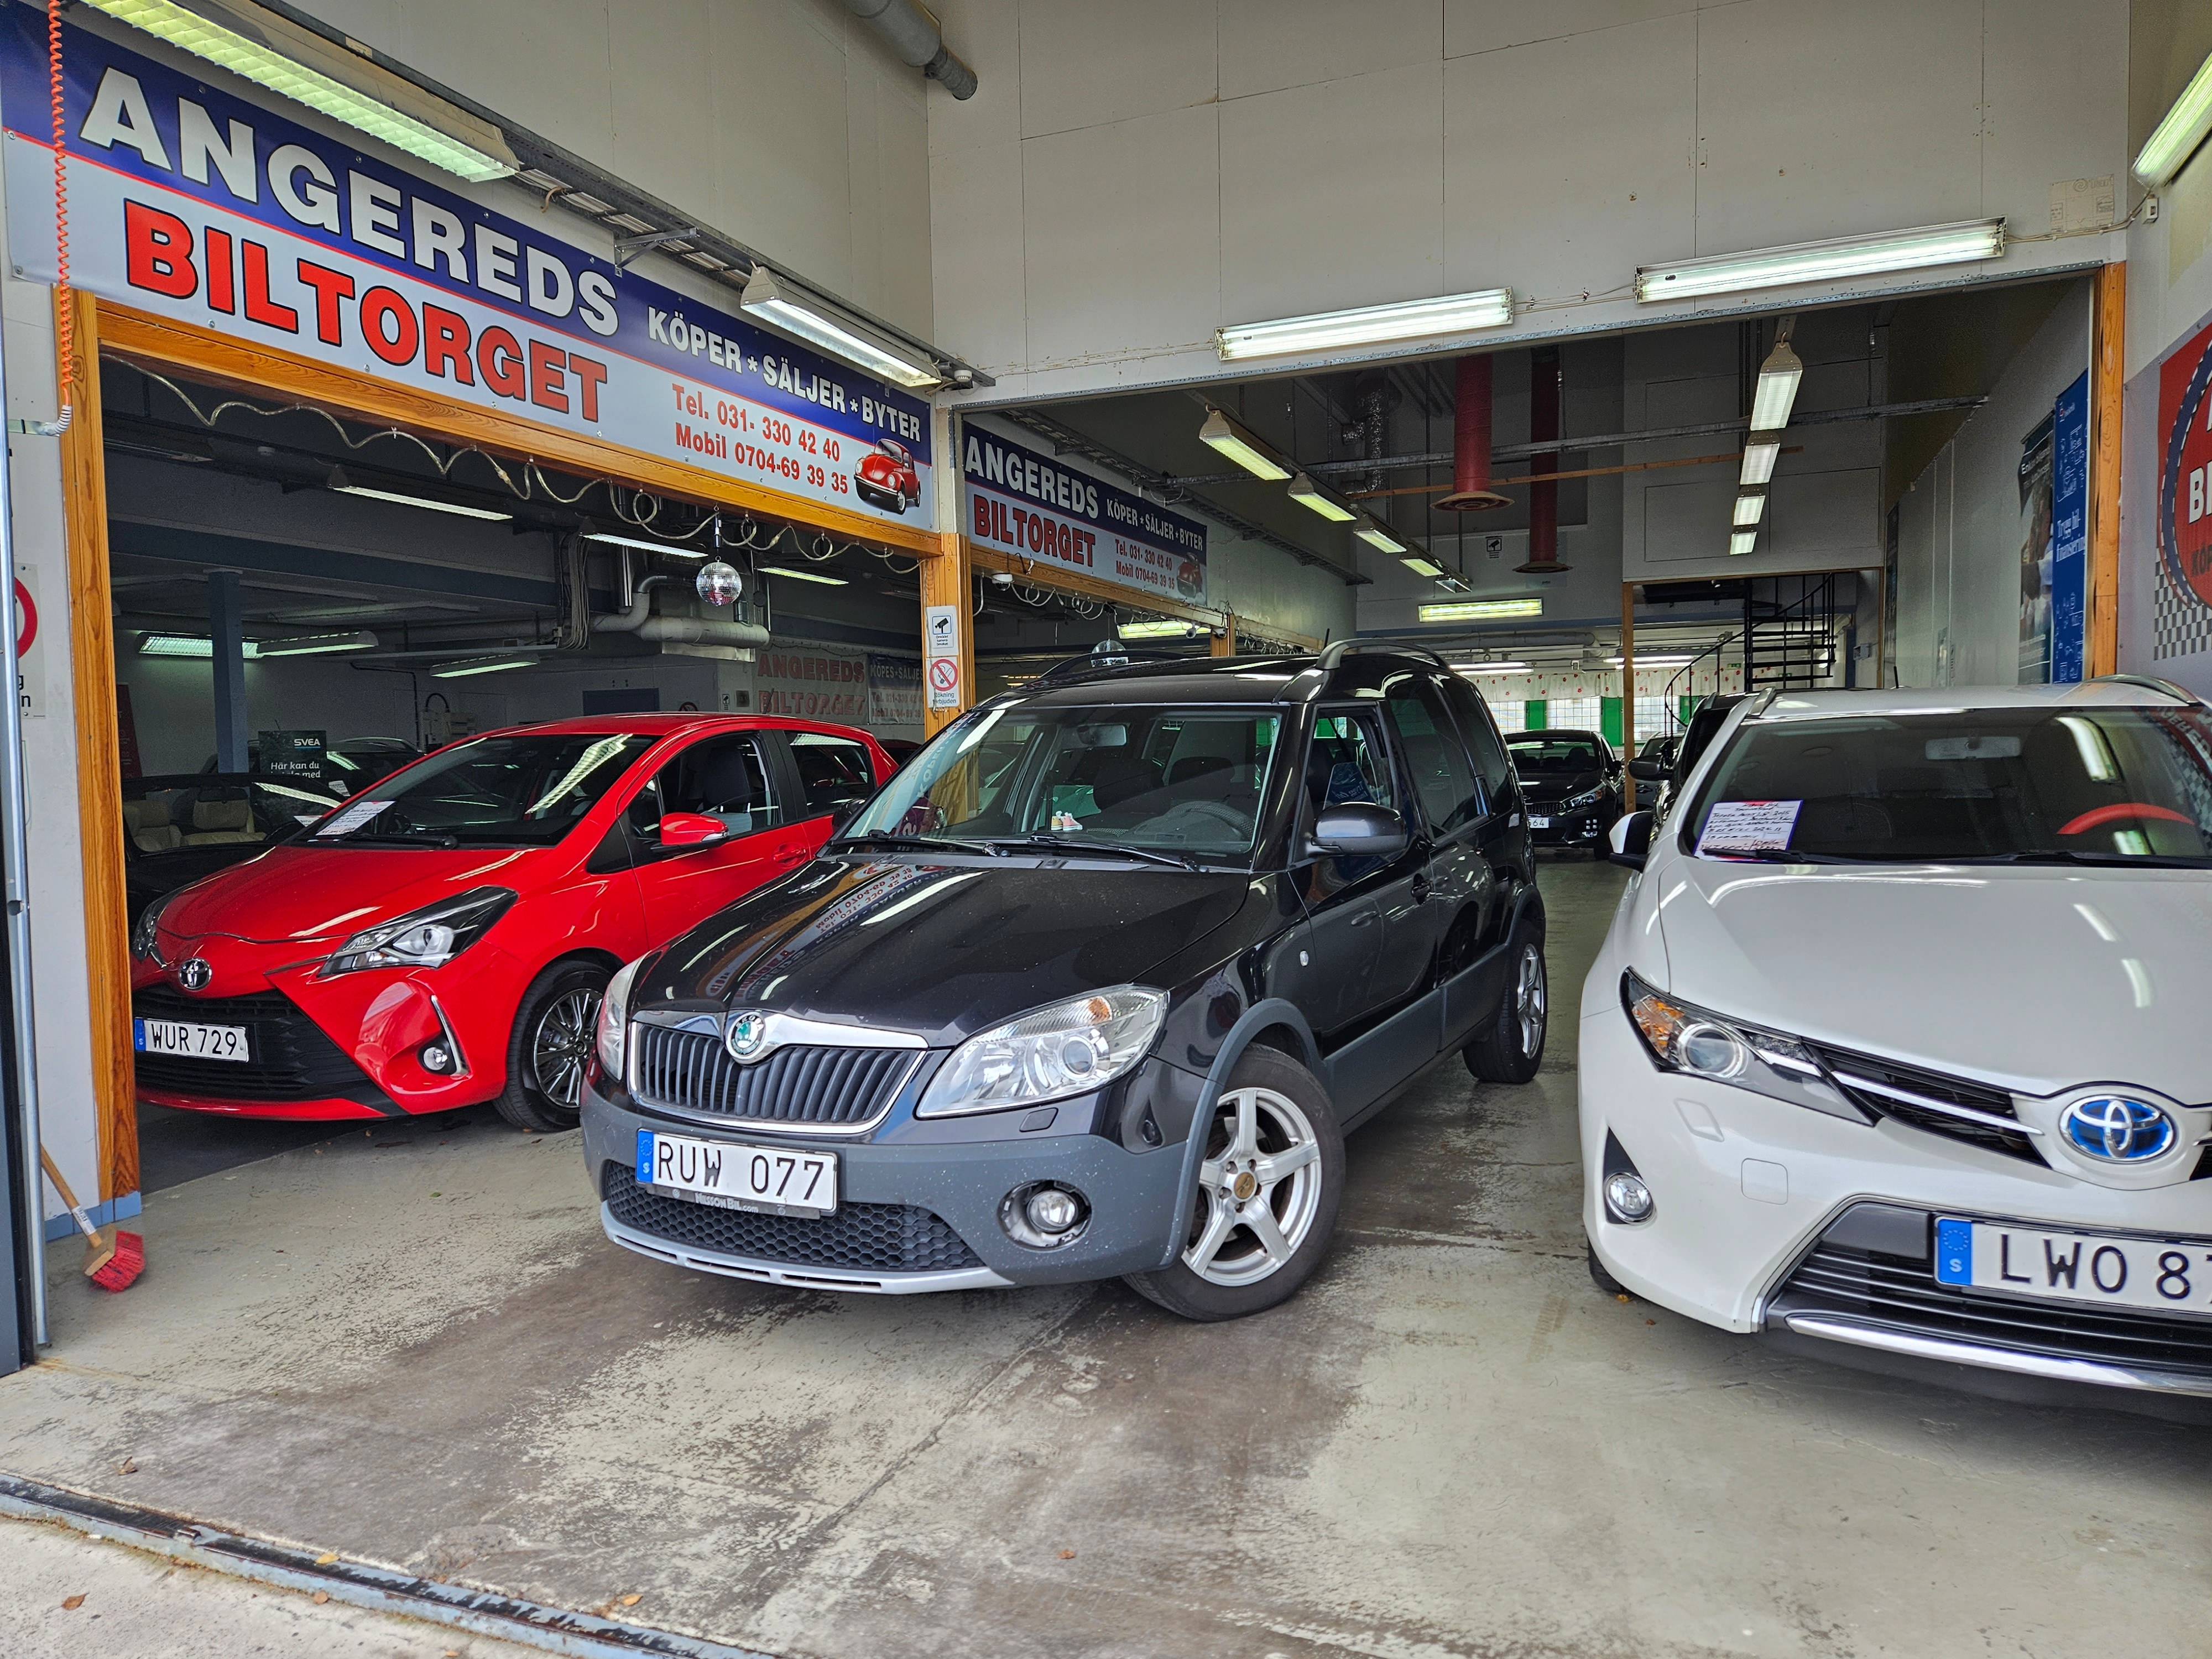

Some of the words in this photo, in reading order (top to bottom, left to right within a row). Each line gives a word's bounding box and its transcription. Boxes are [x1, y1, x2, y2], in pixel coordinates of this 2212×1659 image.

[79, 66, 619, 336] ANGEREDS
[124, 198, 607, 423] BILTORGET
[648, 306, 742, 374] KÖPER
[763, 356, 846, 415] SÄLJER
[861, 395, 920, 442] BYTER
[672, 383, 709, 421] Tel.
[717, 399, 755, 433] 031-
[762, 416, 791, 446] 330
[798, 429, 817, 456] 42
[821, 439, 840, 462] 40
[675, 422, 727, 460] Mobil
[734, 441, 800, 481] 0704-69
[807, 465, 825, 489] 39
[831, 472, 848, 494] 35
[965, 436, 1099, 519] ANGEREDS
[974, 494, 1095, 567] BILTORGET
[1107, 498, 1138, 527] KÖPER
[1145, 511, 1173, 541] SÄLJER
[1179, 529, 1203, 551] BYTER
[1115, 538, 1127, 556] Tel.
[1156, 552, 1164, 568] 42
[1165, 555, 1172, 572] 40
[1116, 560, 1133, 578] Mobil
[1135, 566, 1158, 585] 0704-69
[1160, 571, 1167, 587] 39
[1168, 574, 1175, 590] 35
[757, 653, 865, 683] ANGEREDS
[759, 690, 866, 716] BILTORGET
[271, 762, 288, 770] Här
[290, 761, 307, 770] kan
[309, 760, 320, 769] du
[302, 769, 321, 779] med
[151, 1023, 190, 1052] WUR
[197, 1027, 237, 1056] 729
[642, 1162, 650, 1175] S
[658, 1141, 722, 1187] RUW
[750, 1155, 824, 1201] 077
[1949, 1258, 1962, 1272] S
[2000, 1233, 2127, 1294] LWO
